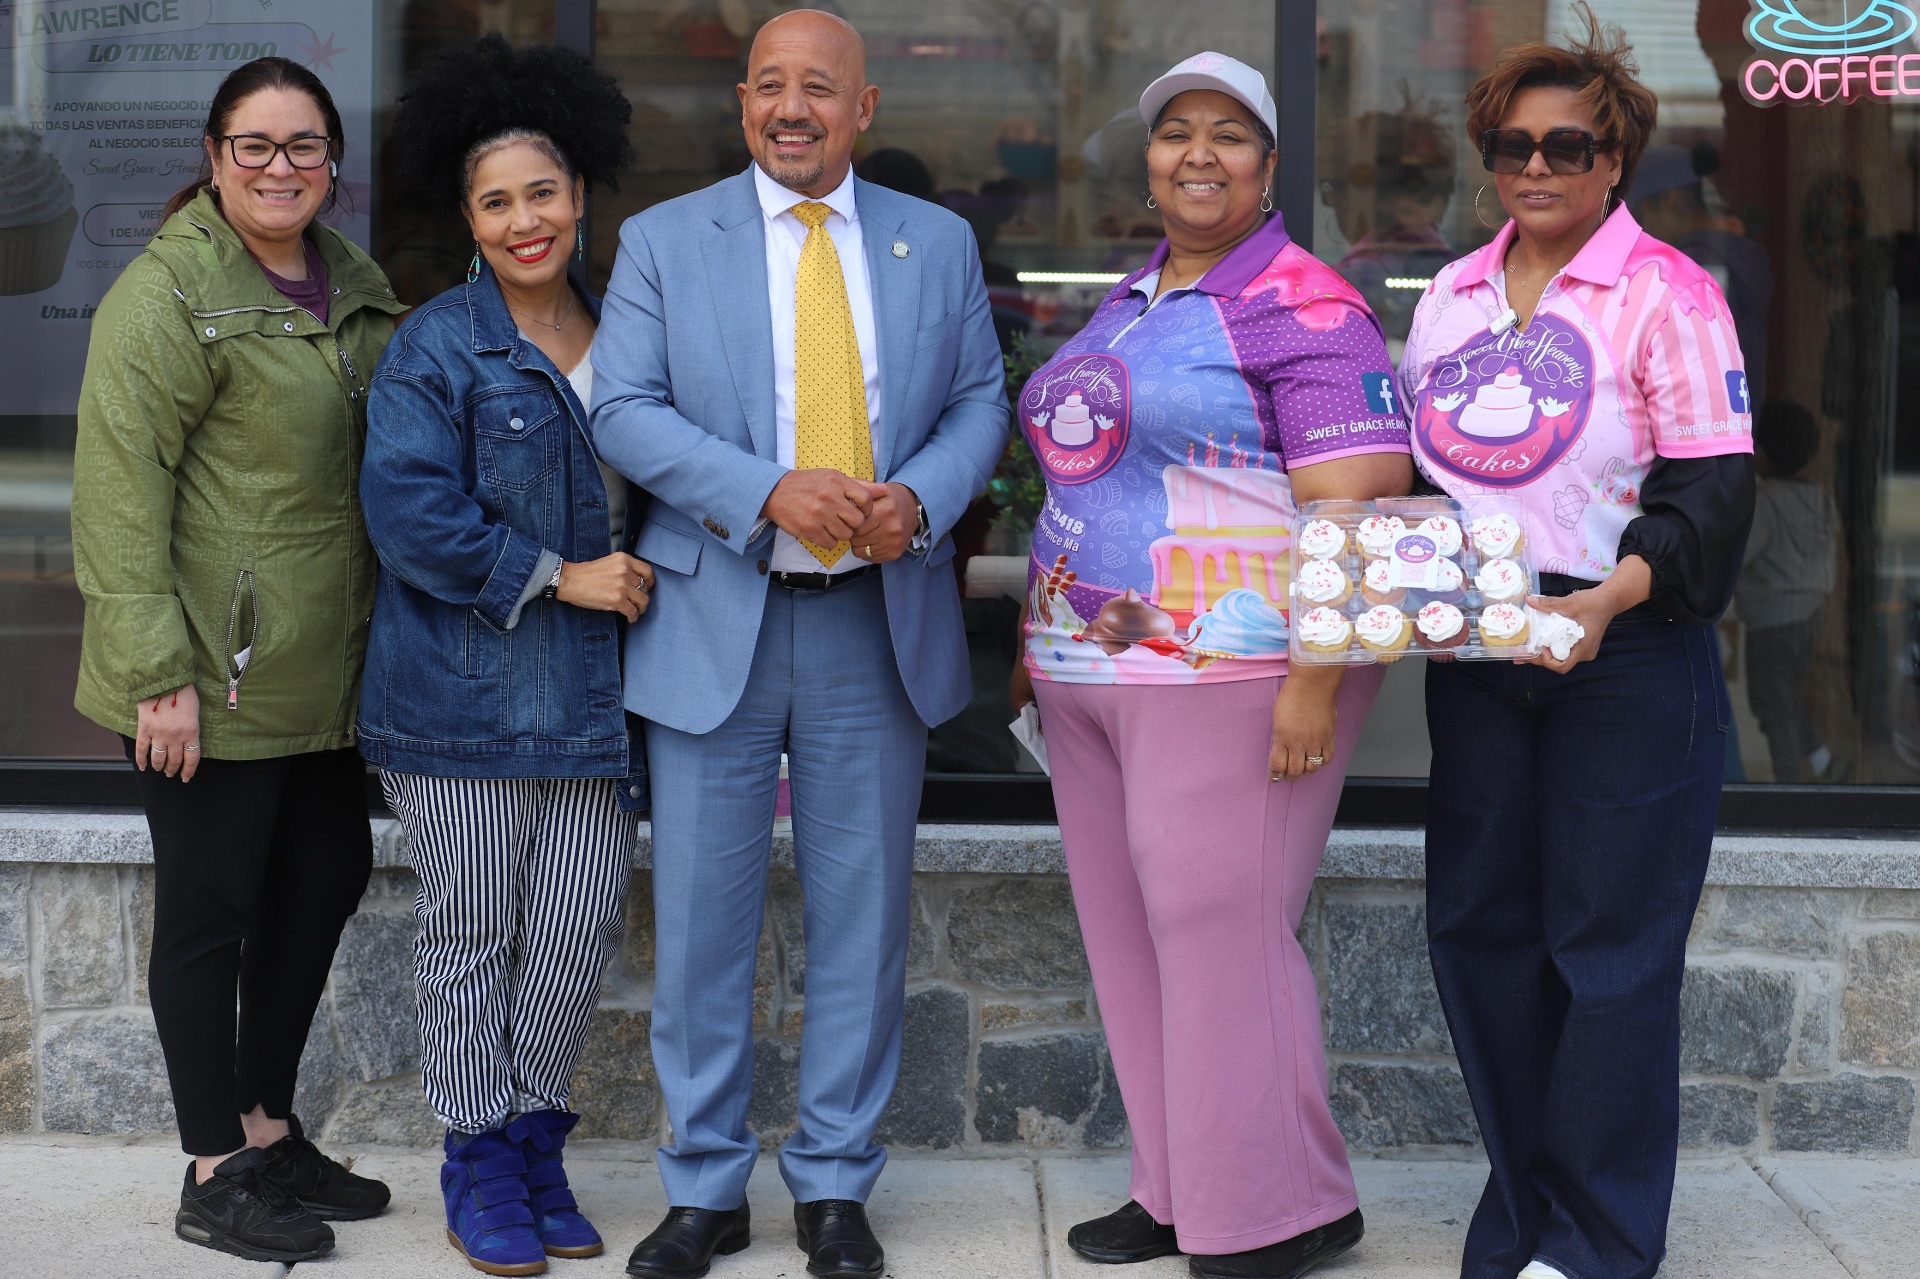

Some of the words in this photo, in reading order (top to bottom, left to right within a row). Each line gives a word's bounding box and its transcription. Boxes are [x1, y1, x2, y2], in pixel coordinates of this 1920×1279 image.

[17, 0, 181, 37] LAWRENCE
[87, 44, 122, 63] LO
[125, 43, 203, 62] TIENE
[203, 42, 279, 61] TODO
[1745, 54, 1920, 101] COFFEE
[53, 102, 121, 112] APOYANDO
[123, 101, 142, 111] UN
[144, 101, 198, 111] NEGOCIO
[30, 121, 70, 131] TODAS
[72, 121, 94, 131] LAS
[97, 120, 144, 130] VENTAS
[89, 139, 104, 149] AL
[106, 138, 160, 148] NEGOCIO
[83, 159, 120, 176] Sweet
[121, 159, 155, 181] Grace
[110, 229, 114, 237] 1
[116, 228, 132, 238] DE
[75, 260, 93, 269] 100
[96, 260, 111, 269] DE
[41, 305, 78, 319] Una
[1305, 423, 1346, 441] SWEET
[1349, 419, 1384, 433] GRACE
[1675, 422, 1711, 437] SWEET
[1713, 419, 1742, 433] GRACE
[1044, 447, 1103, 471] Cakes
[1439, 439, 1540, 473] Cakes
[1063, 537, 1080, 552] Ma
